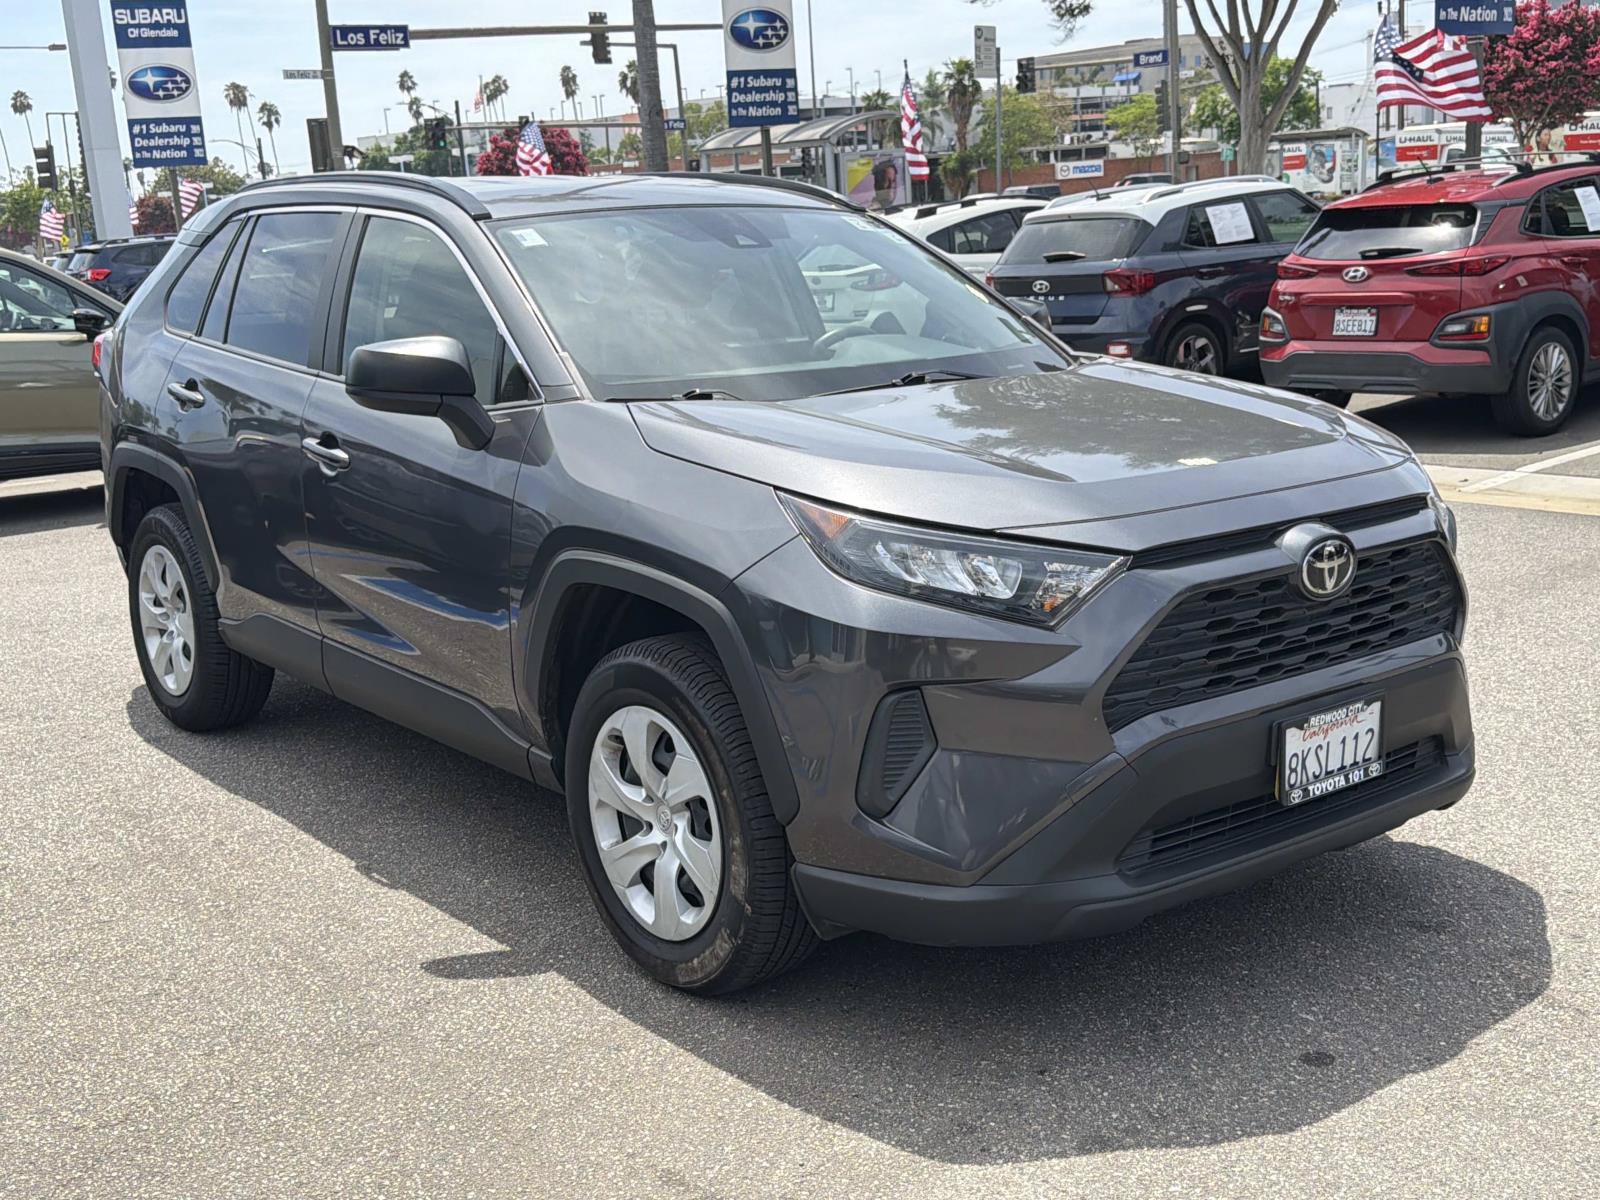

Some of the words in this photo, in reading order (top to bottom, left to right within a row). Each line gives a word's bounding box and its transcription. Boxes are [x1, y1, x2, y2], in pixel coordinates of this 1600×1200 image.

[114, 8, 186, 24] SUBARU
[1439, 9, 1446, 20] In
[1447, 9, 1458, 20] The
[1459, 6, 1497, 22] Nation
[128, 28, 138, 38] Of
[140, 28, 179, 37] Glendale
[337, 29, 365, 45] Los
[369, 29, 405, 45] Feliz
[1139, 52, 1163, 65] Brand
[731, 76, 745, 88] #1
[746, 75, 782, 87] Subaru
[731, 90, 785, 103] Dealership
[748, 105, 782, 117] Nation
[132, 124, 146, 134] #1
[149, 123, 186, 134] Subaru
[134, 135, 191, 147] Dealership
[1398, 135, 1435, 144] U-HAUL
[152, 148, 188, 159] Nation
[1072, 165, 1102, 174] mazda
[1310, 710, 1346, 727] REDWOOD
[1349, 701, 1363, 715] CITY
[1303, 715, 1364, 741] California
[1288, 728, 1374, 788] 8KSL112
[1308, 777, 1346, 797] TOYOTA
[1348, 769, 1364, 783] 101
